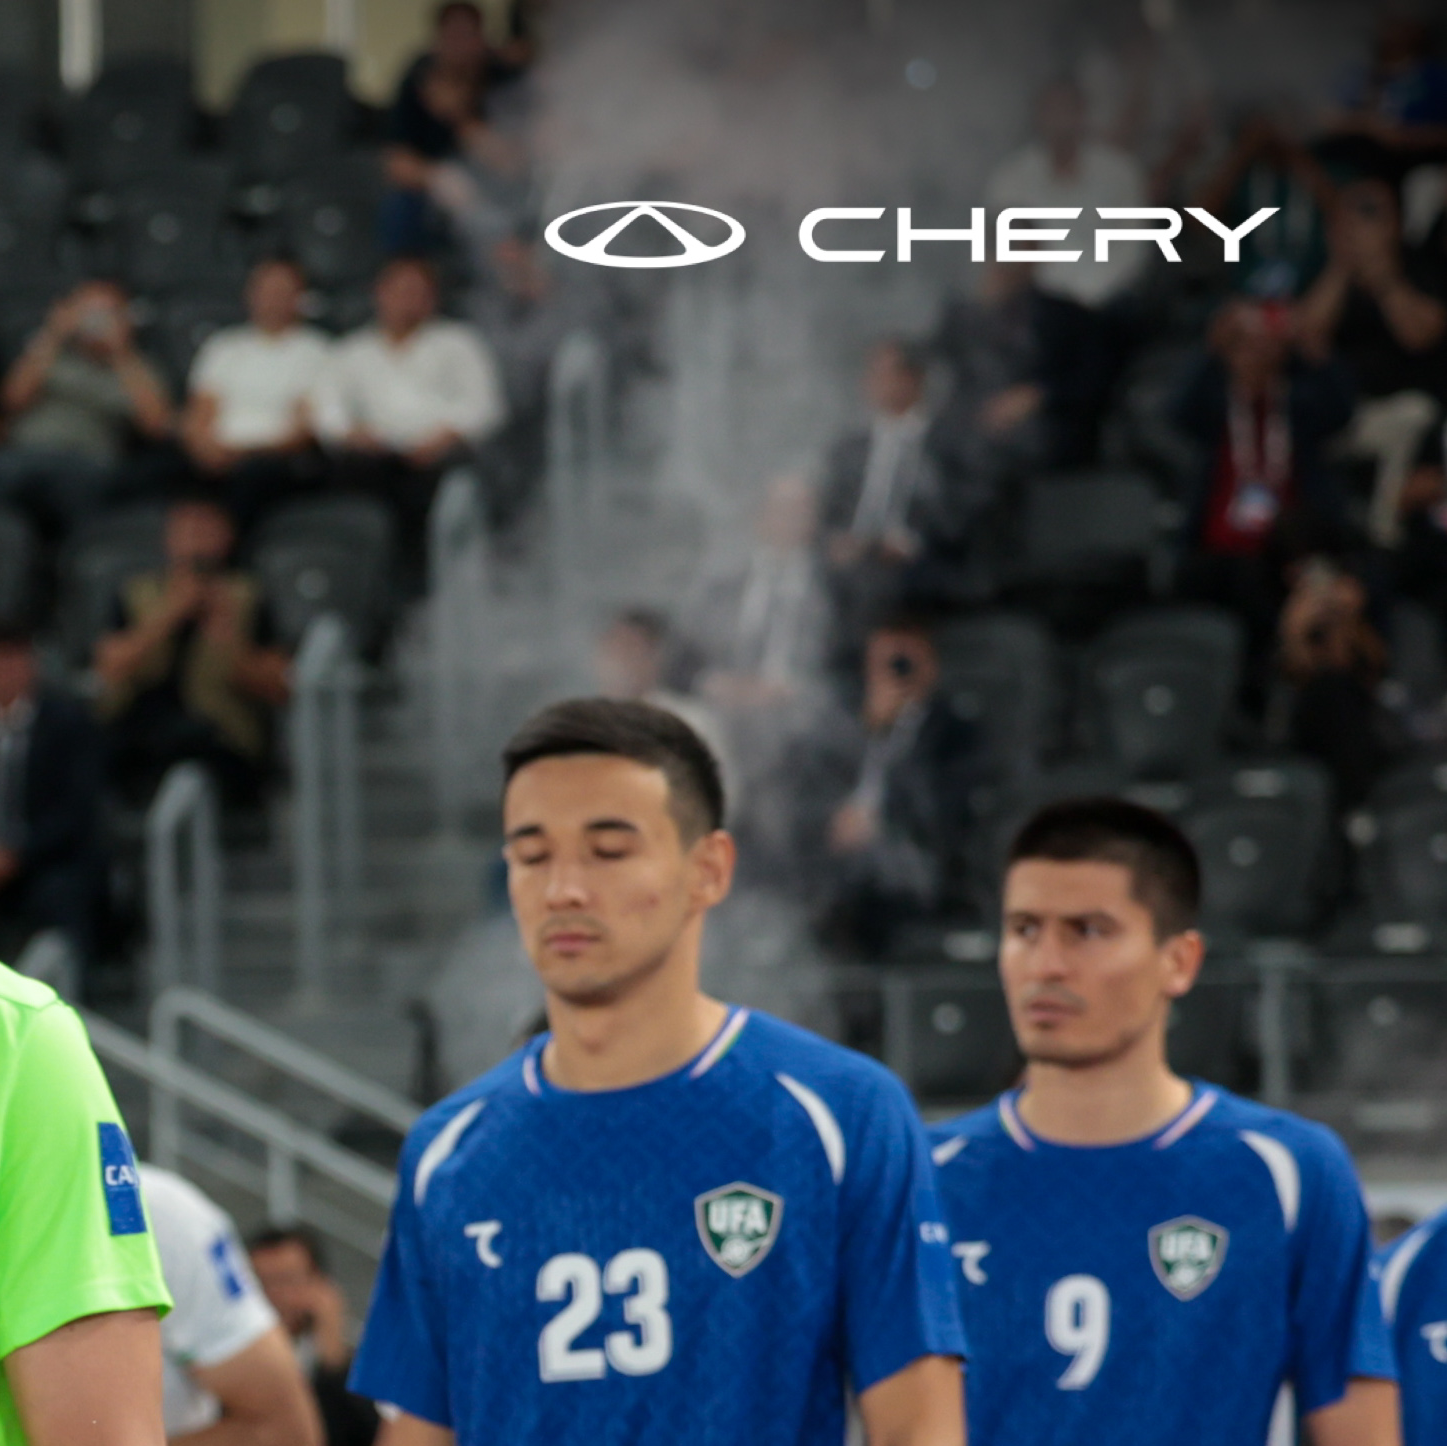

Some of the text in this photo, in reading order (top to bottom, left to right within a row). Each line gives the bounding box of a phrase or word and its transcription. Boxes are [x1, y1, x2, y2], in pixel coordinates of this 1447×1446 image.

[707, 1197, 770, 1236] UFA
[535, 1247, 673, 1383] 23
[1044, 1274, 1110, 1391] 9
